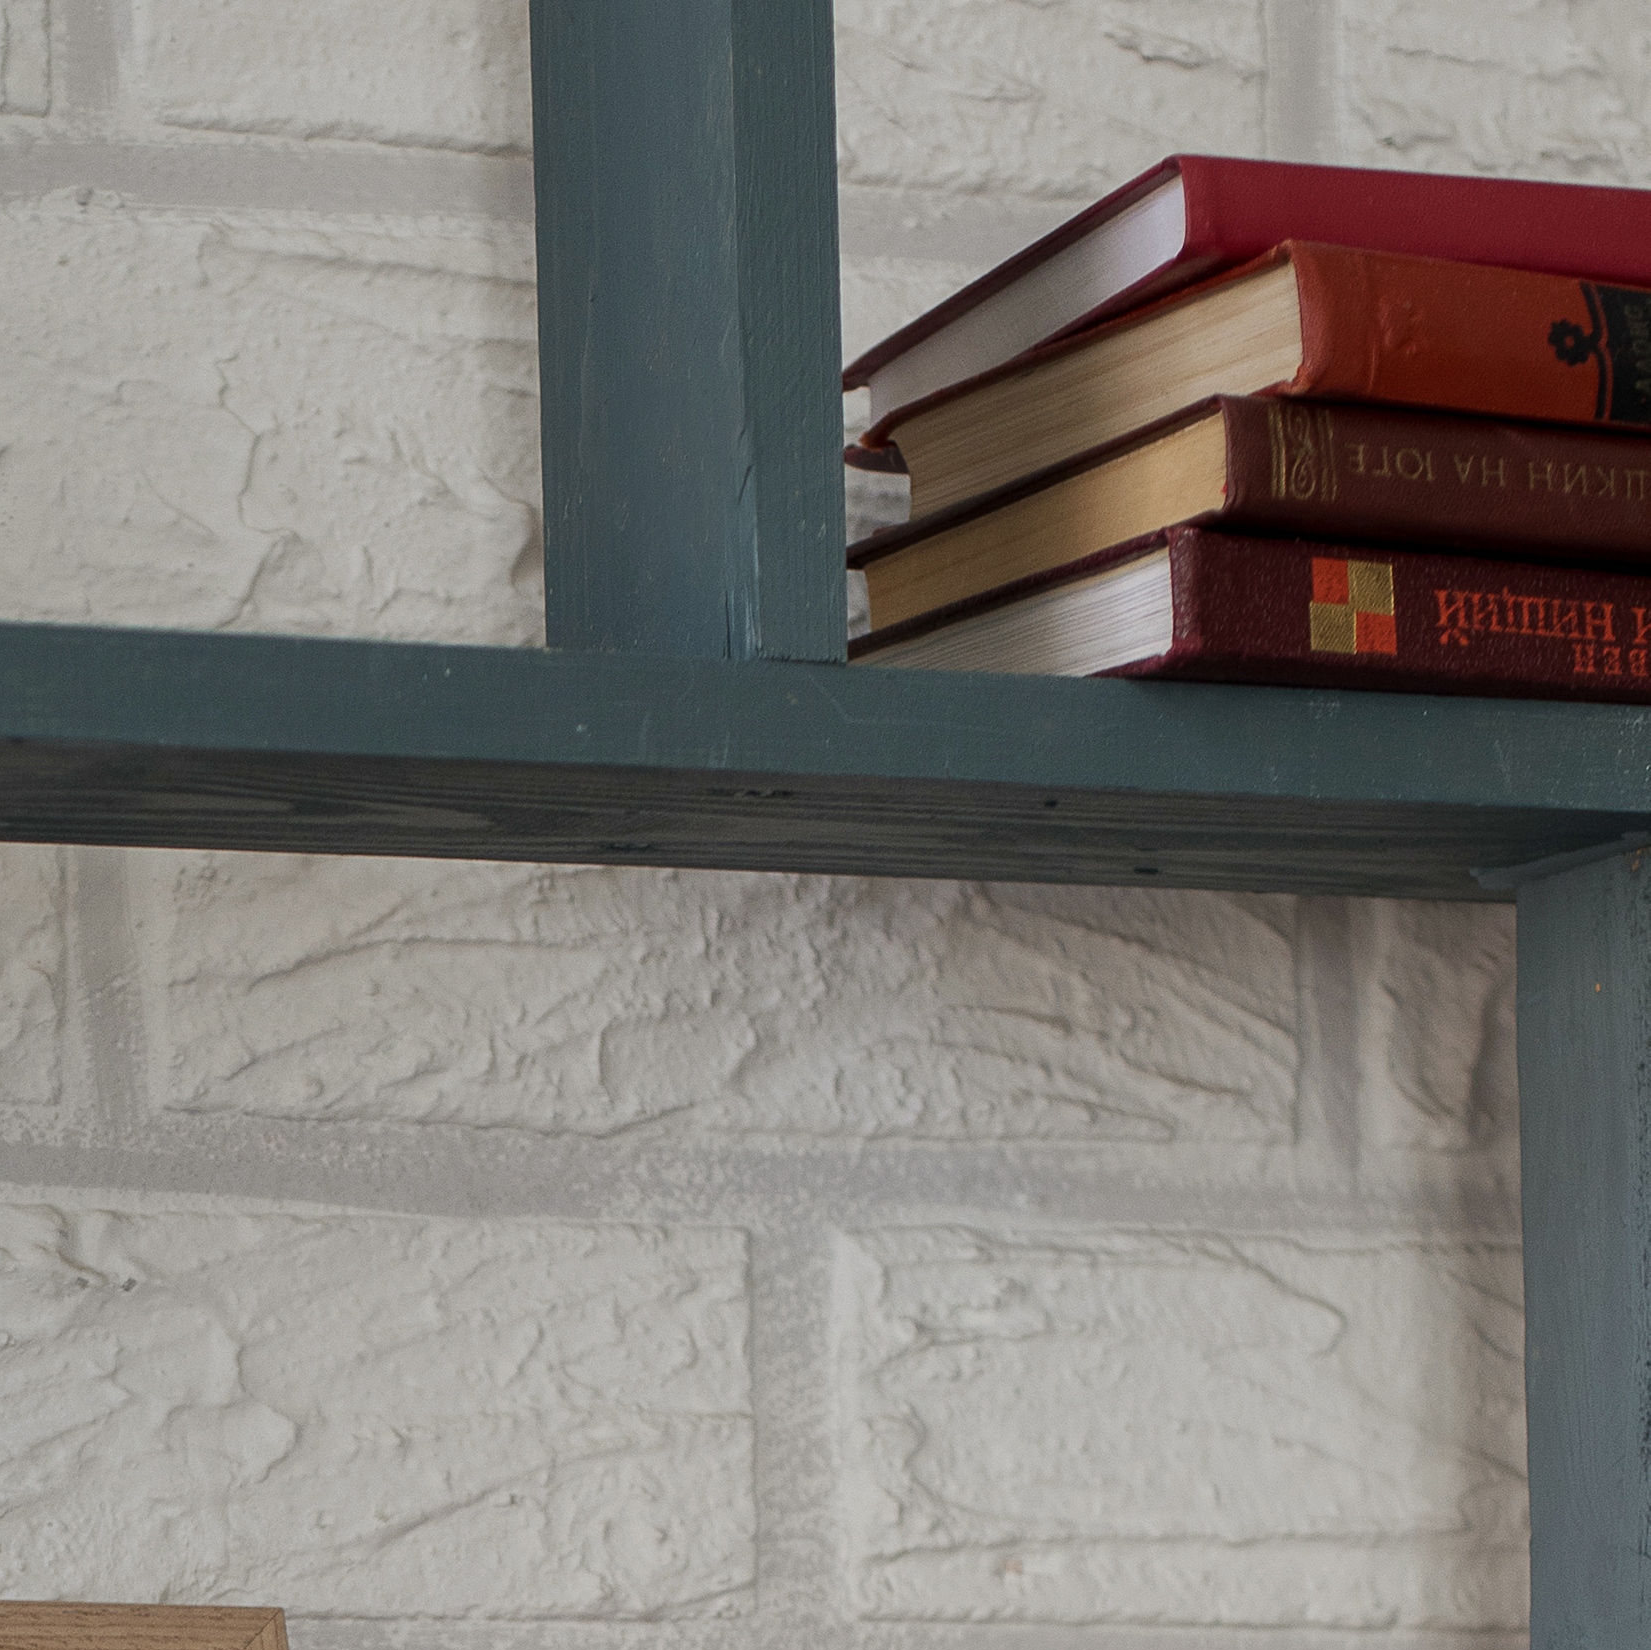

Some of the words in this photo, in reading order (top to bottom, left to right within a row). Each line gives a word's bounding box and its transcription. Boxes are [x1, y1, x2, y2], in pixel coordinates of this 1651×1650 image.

[1346, 443, 1435, 481] ЮГЕ
[1453, 453, 1506, 488] НА
[1434, 586, 1616, 646] НИЩИЙ
